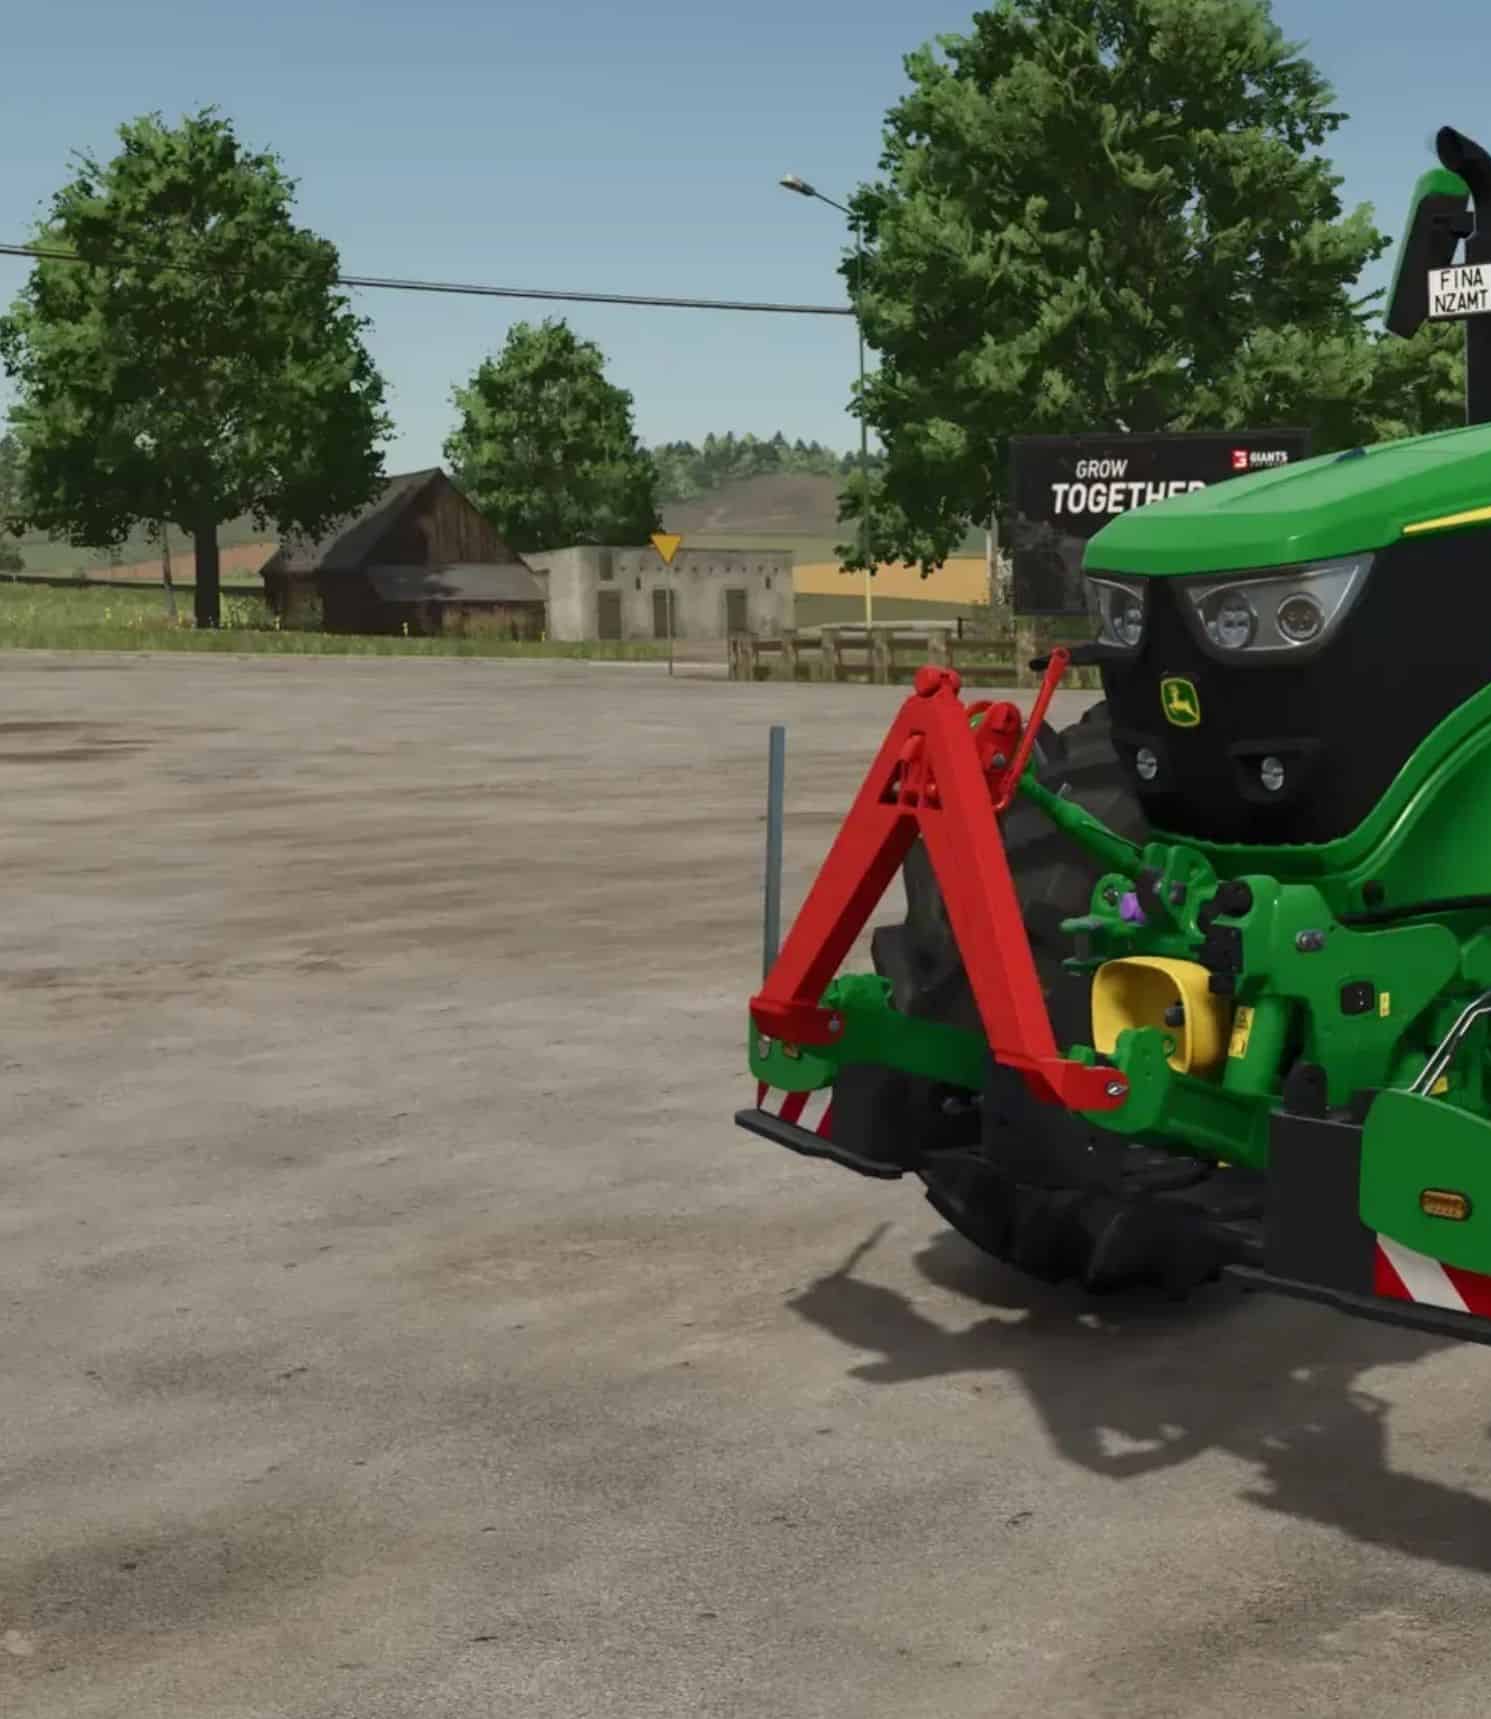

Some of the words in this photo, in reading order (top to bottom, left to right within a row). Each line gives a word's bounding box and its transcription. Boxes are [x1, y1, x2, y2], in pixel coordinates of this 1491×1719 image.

[1440, 268, 1484, 290] FINA
[1434, 289, 1488, 313] NZAMT
[1249, 450, 1288, 464] GIANTS
[1075, 459, 1128, 479] GROW
[1051, 480, 1207, 515] TOGETH
